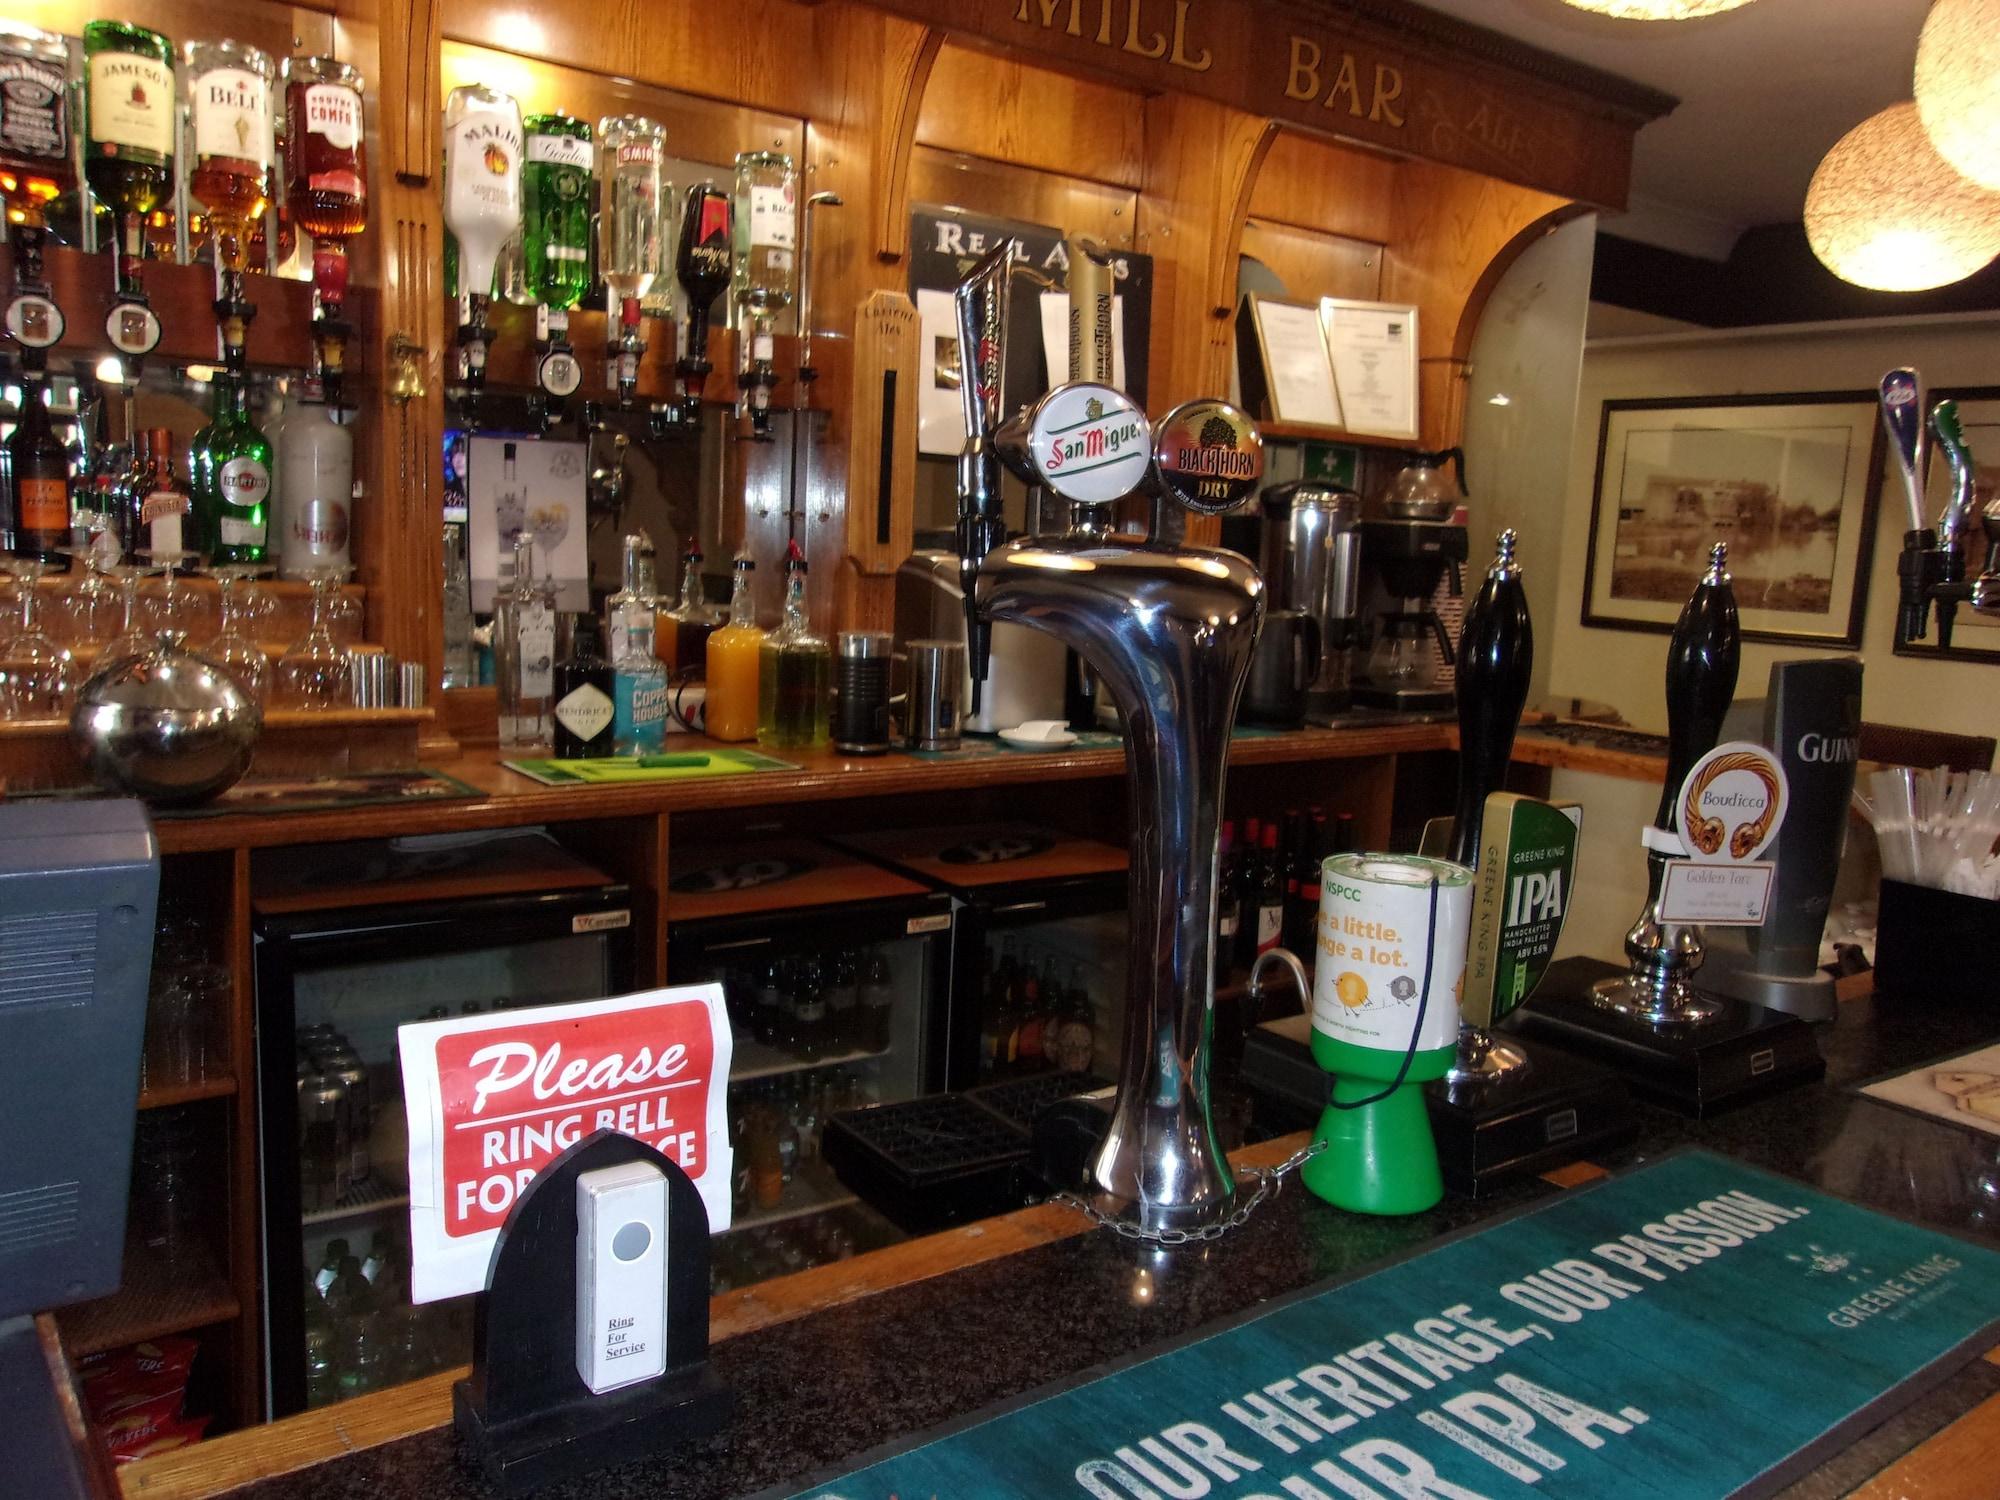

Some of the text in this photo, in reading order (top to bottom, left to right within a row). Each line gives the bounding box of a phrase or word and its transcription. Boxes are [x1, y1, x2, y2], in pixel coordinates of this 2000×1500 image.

[1284, 36, 1405, 127] BAR
[935, 220, 1130, 280] REL AS
[1197, 480, 1232, 498] DRY
[1703, 790, 1765, 809] Boudicca
[1513, 846, 1566, 864] GREENE KING
[1686, 870, 1725, 885] Golden
[1326, 880, 1362, 903] NSPCC
[1505, 868, 1562, 929] IPA
[1330, 915, 1340, 930] a
[1344, 915, 1403, 943] little.
[1504, 923, 1551, 939] HANDCRAFTED
[1503, 937, 1523, 949] INDIA
[1524, 933, 1538, 945] PALE
[1351, 946, 1364, 961] a
[1369, 946, 1409, 968] lot.
[469, 1042, 689, 1114] Please
[483, 1114, 583, 1169] RING
[1826, 1279, 1918, 1328] GREENE
[1901, 1253, 1962, 1286] KING
[608, 1315, 635, 1331] Ring
[605, 1341, 646, 1359] Service
[607, 1332, 628, 1346] For
[1074, 1421, 1264, 1500] OUR
[1221, 1303, 1554, 1454] HERITAGE,
[1500, 1259, 1644, 1324] OUR
[1590, 1189, 1811, 1281] PASSION.
[1416, 1372, 1651, 1485] IPA.
